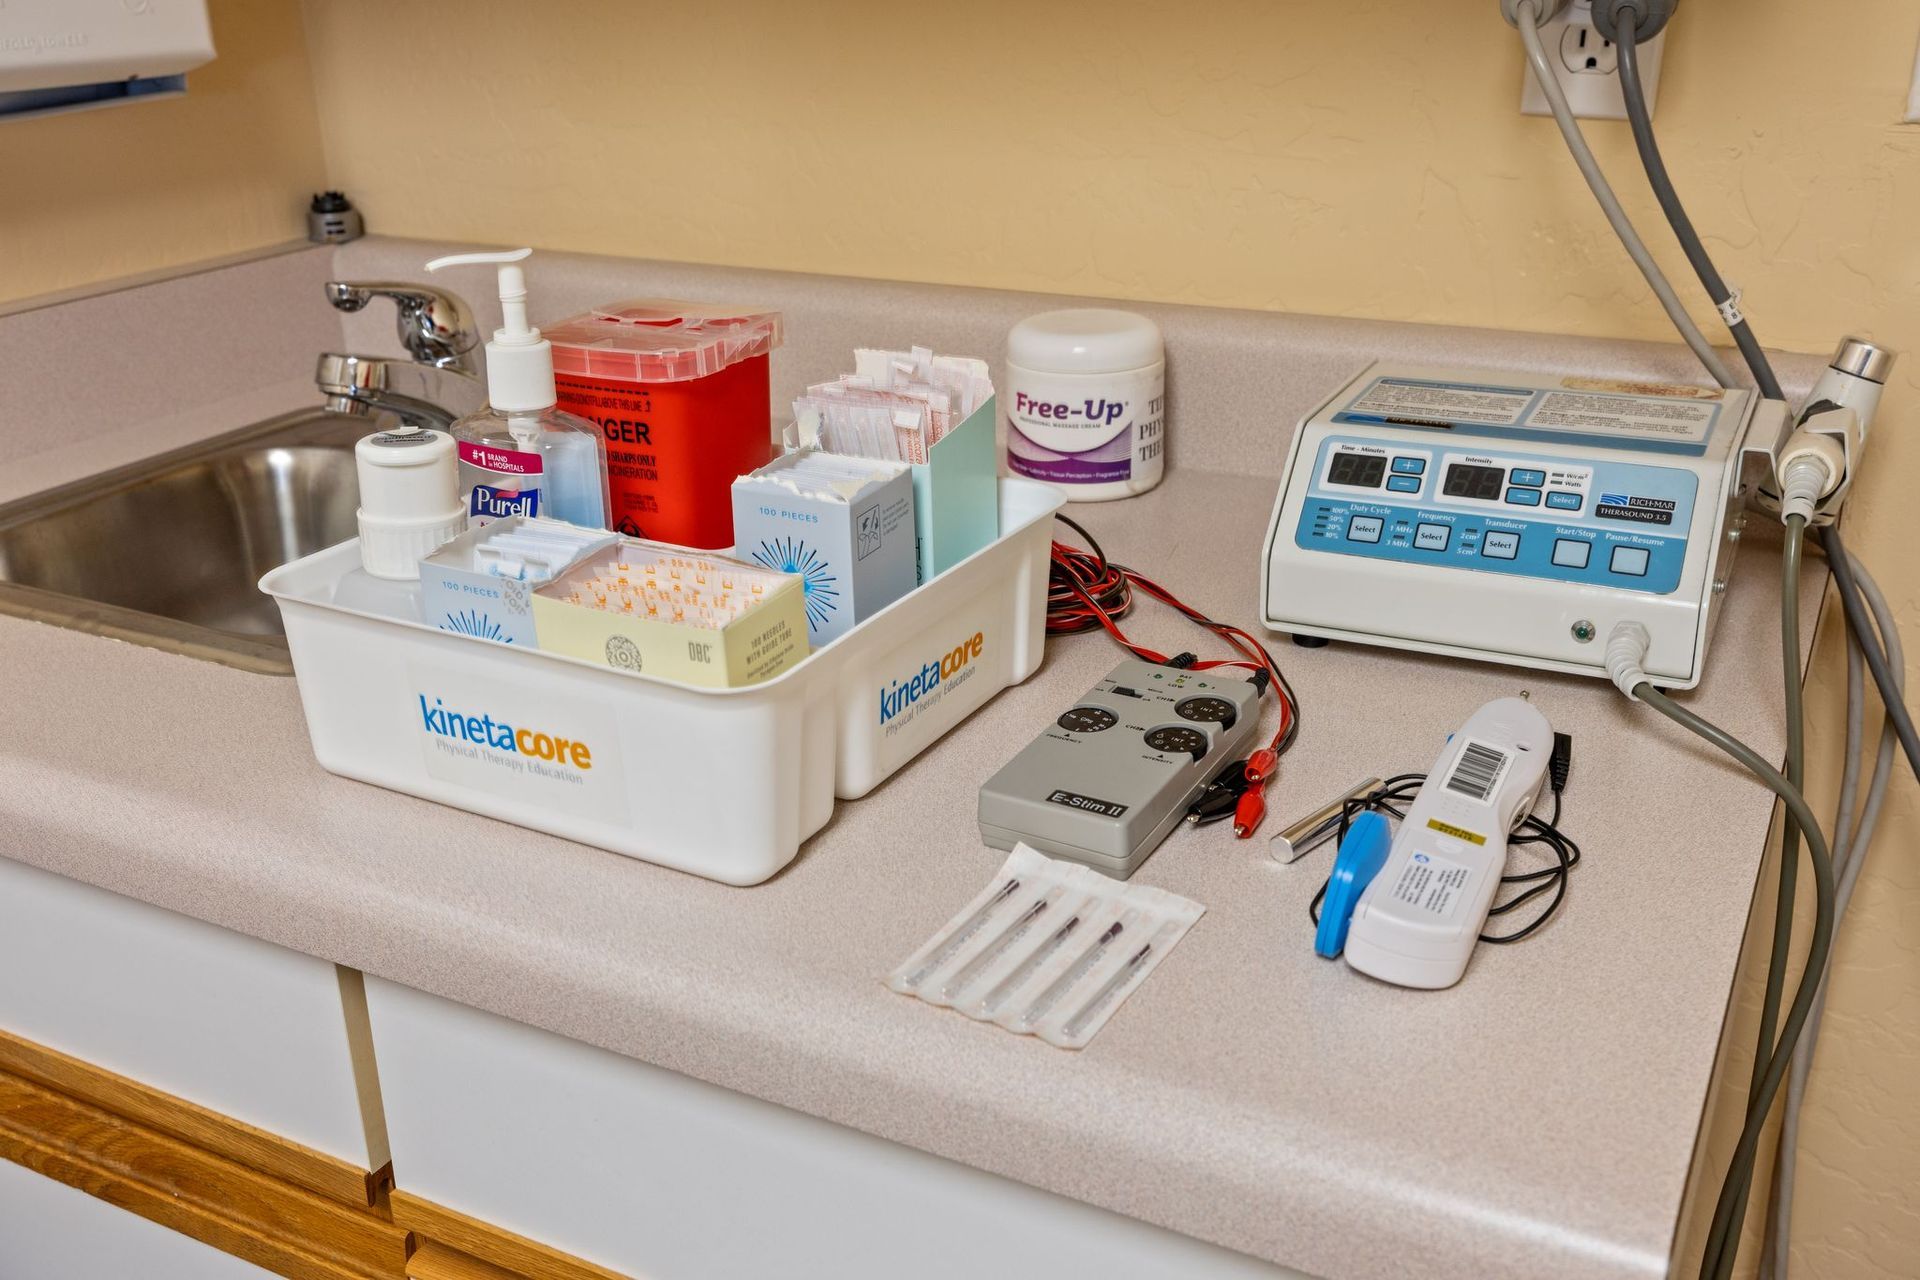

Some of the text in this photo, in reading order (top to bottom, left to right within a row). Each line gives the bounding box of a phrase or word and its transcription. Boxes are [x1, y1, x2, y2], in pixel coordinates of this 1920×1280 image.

[1361, 446, 1385, 454] Minutes
[472, 449, 486, 466] #1
[487, 453, 508, 462] BRAND
[637, 454, 656, 467] ONLY
[493, 463, 525, 472] HOSPITALS
[476, 487, 532, 519] Purell
[1552, 495, 1577, 505] Select
[759, 507, 819, 524] 100 PIECES
[1350, 503, 1392, 515] Duty Cycle
[1600, 507, 1667, 521] THERASOUND 3.5
[1417, 511, 1456, 523] Frequency
[1355, 525, 1375, 533] Select
[1394, 526, 1413, 534] MHz
[1485, 519, 1527, 530] Transducer
[1421, 532, 1443, 541] Select
[1555, 526, 1597, 539] Start/Stop
[1605, 532, 1665, 546] Pause/Resume
[1391, 540, 1410, 548] MHz
[1489, 540, 1512, 549] Select
[442, 581, 499, 599] 100 PIECES
[762, 620, 785, 641] NEEDLES
[746, 650, 761, 665] WITH
[880, 632, 983, 725] kinetacore
[885, 666, 976, 737] Physical Therapy Education
[419, 693, 592, 770] kinetacore
[436, 738, 583, 785] Physical Therapy Education
[1051, 792, 1122, 816] E-Stim II
